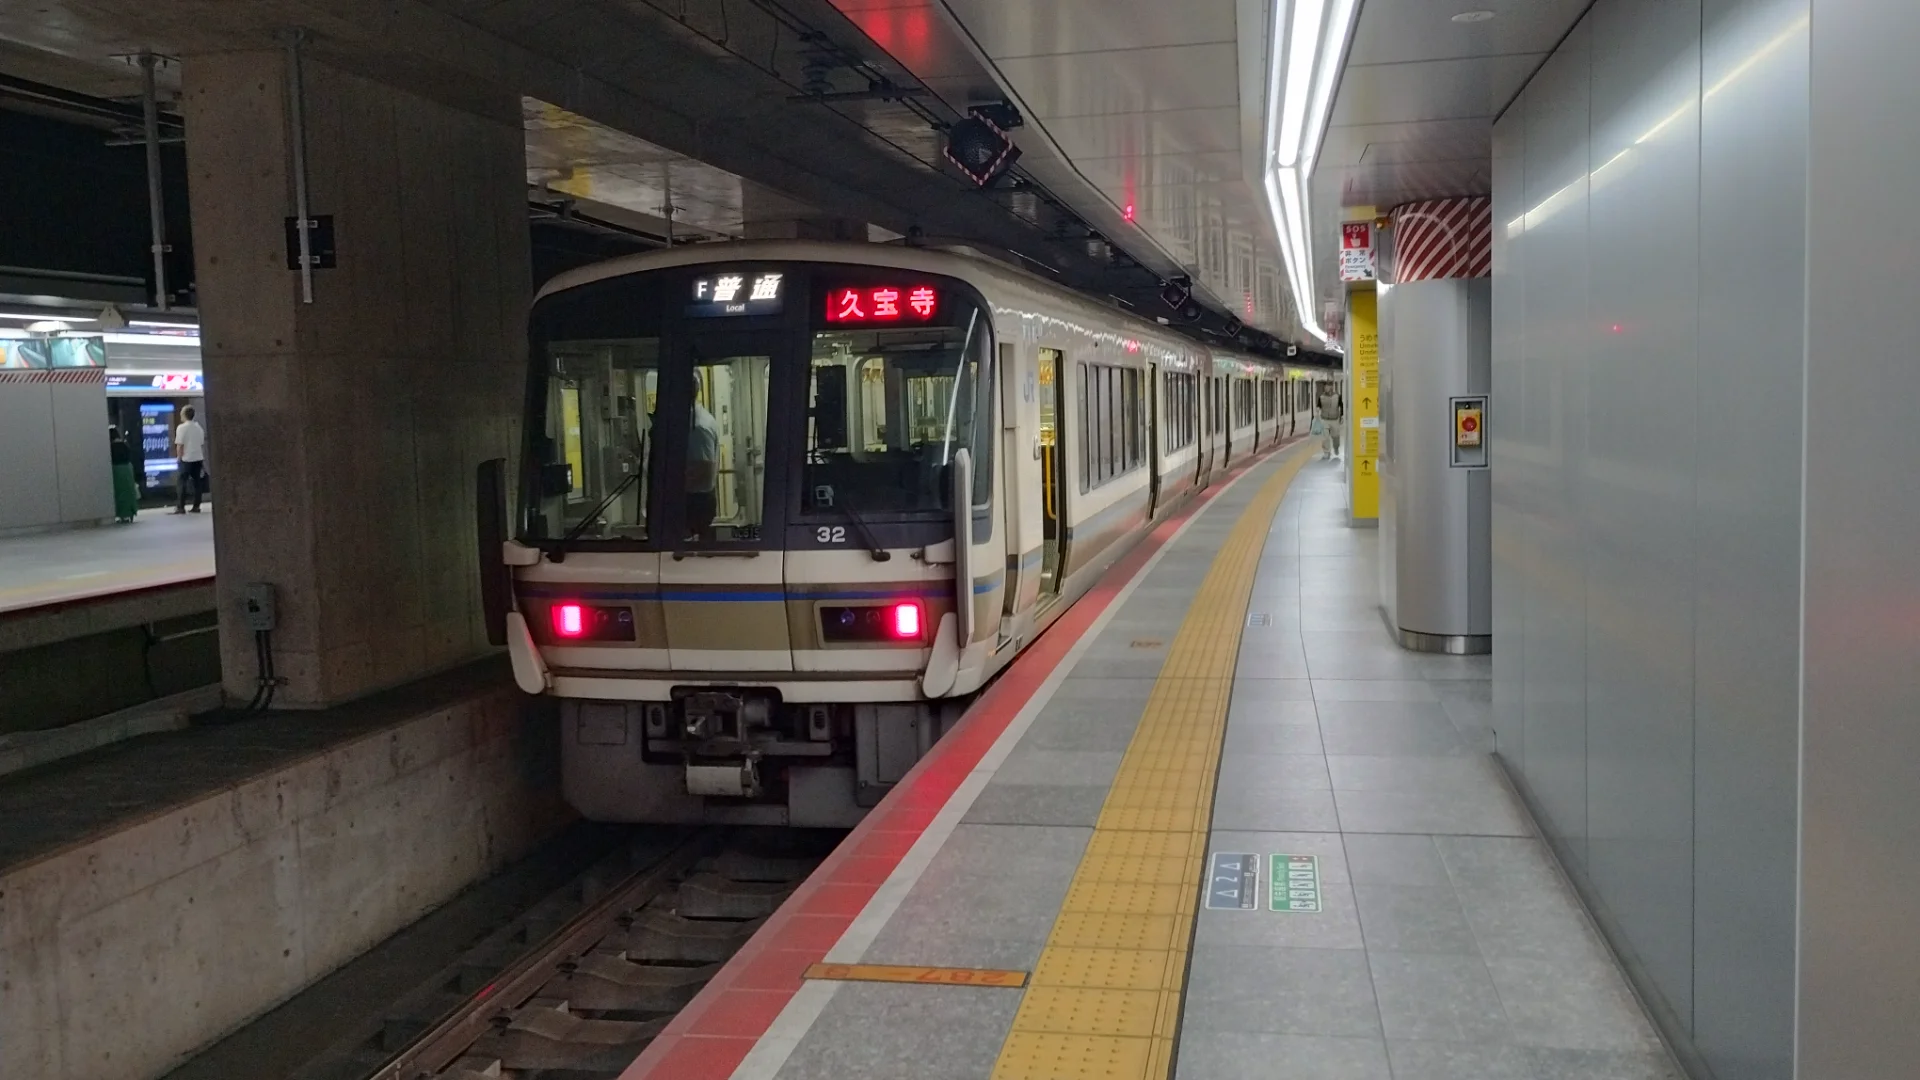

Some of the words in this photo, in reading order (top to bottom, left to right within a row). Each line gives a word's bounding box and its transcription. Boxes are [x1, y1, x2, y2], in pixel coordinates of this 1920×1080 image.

[1346, 225, 1366, 233] SOS
[697, 281, 708, 298] F
[713, 274, 783, 301] 普通
[726, 304, 745, 313] Local
[838, 287, 935, 319] 久宝寺
[817, 526, 846, 543] 32
